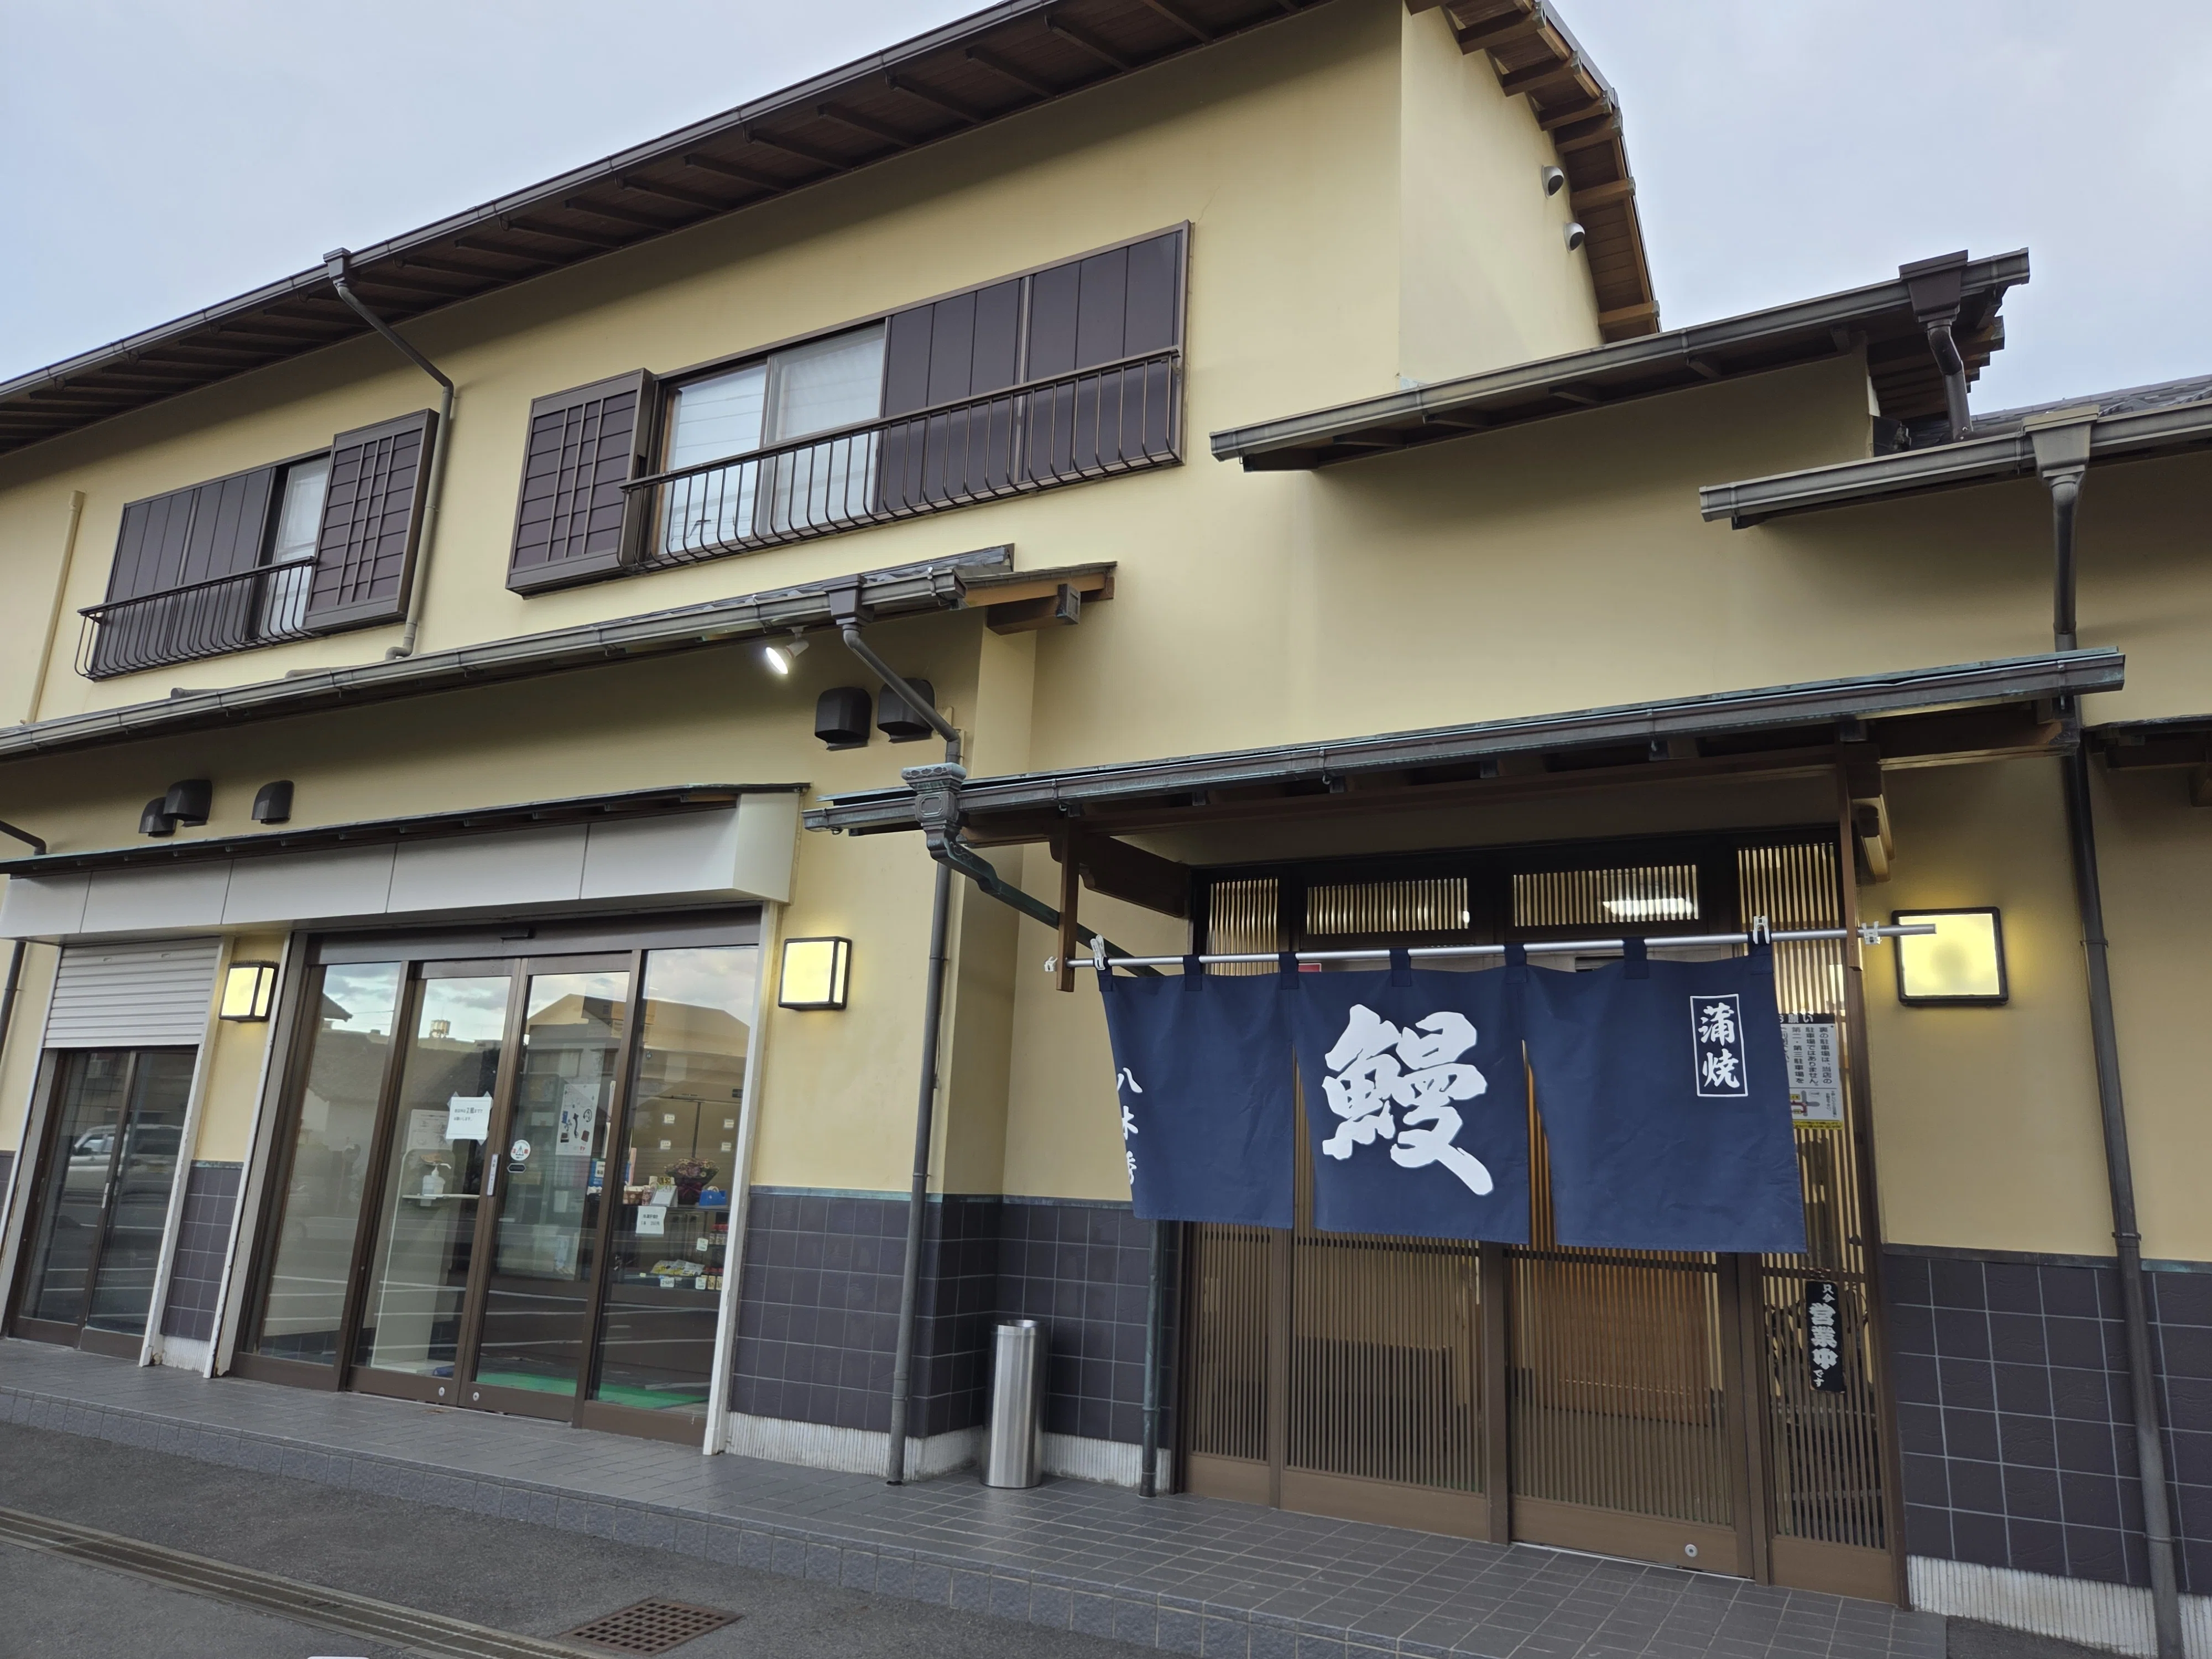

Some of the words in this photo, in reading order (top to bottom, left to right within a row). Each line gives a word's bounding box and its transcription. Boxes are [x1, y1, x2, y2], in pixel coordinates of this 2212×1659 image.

[1698, 1002, 1740, 1088] 蒲焼
[1792, 1026, 1804, 1084] 第二・第三駐車場を
[1805, 1026, 1819, 1087] 駐車場ではありません。
[1819, 1027, 1833, 1084] 裏の駐車場は、当店の
[1322, 1004, 1494, 1196] 鰻
[1808, 1284, 1839, 1387] 只今営業中です
